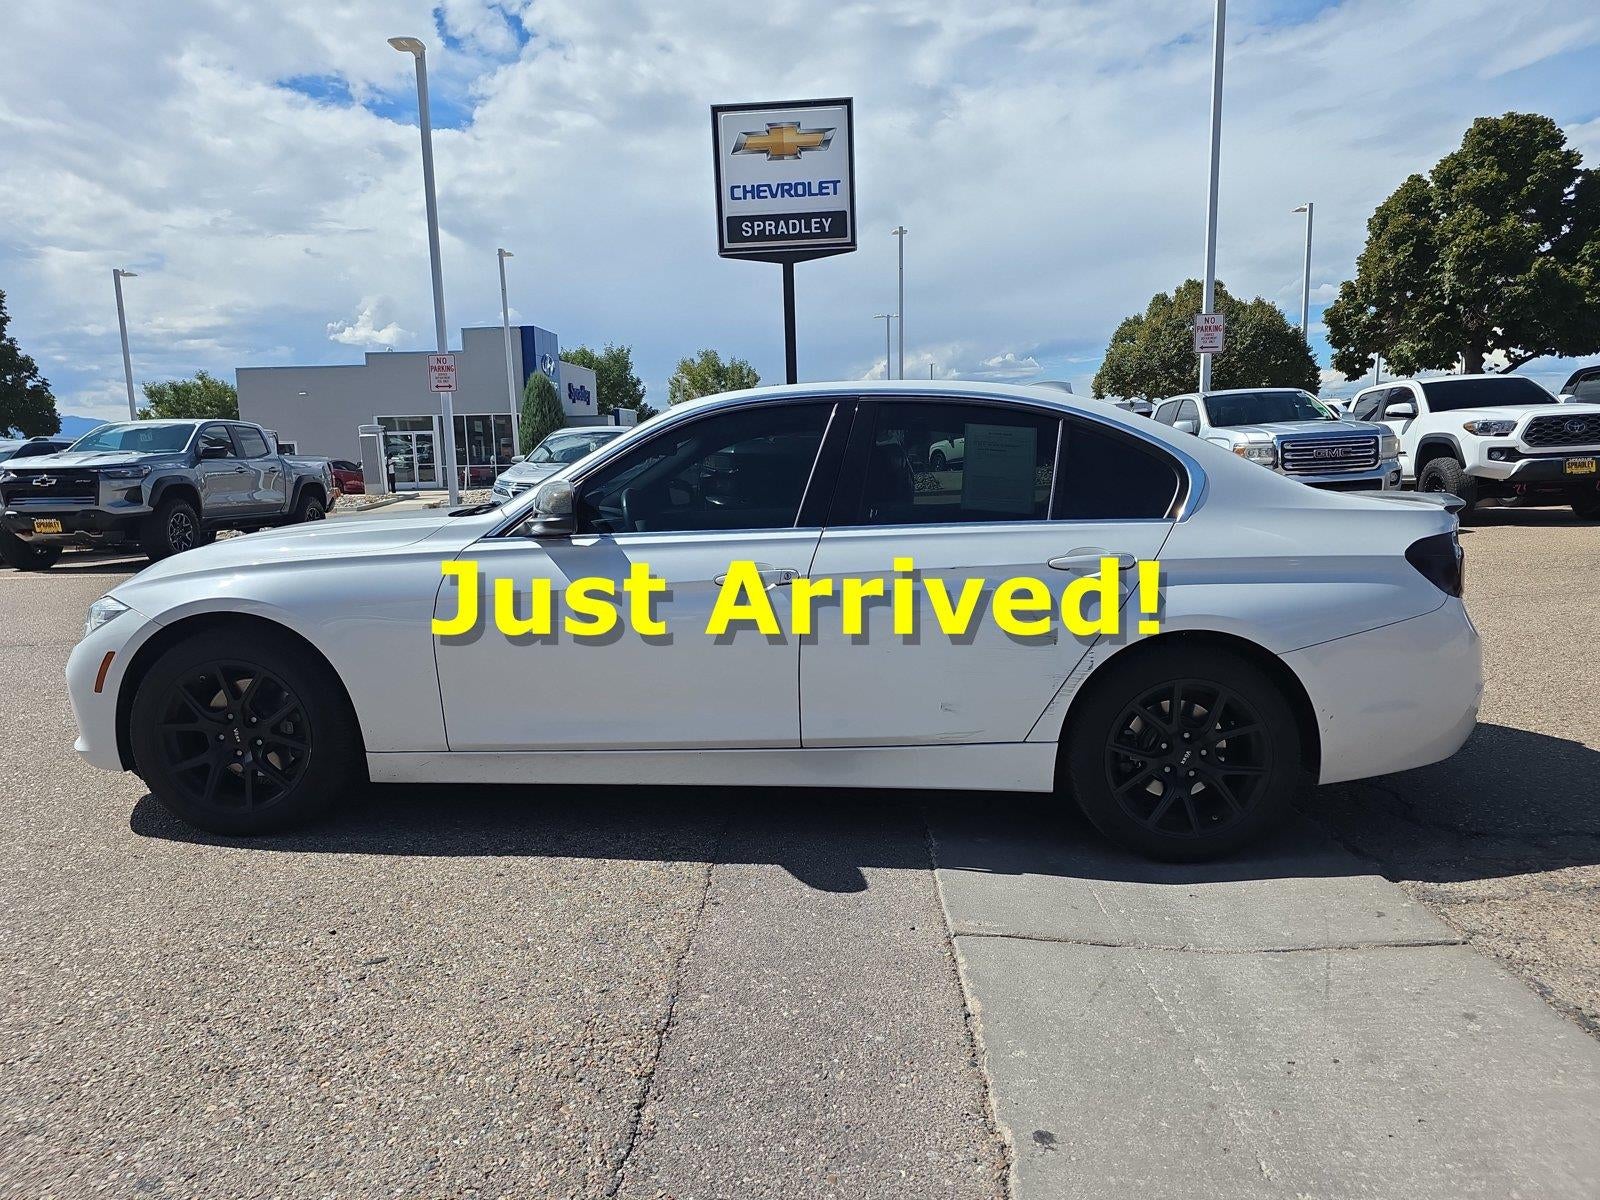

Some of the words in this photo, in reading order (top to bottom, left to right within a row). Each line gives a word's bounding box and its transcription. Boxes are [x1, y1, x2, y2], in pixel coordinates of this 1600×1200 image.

[730, 180, 841, 200] CHEVROLET
[741, 217, 832, 237] SPRADLEY
[1196, 325, 1223, 333] PARKING
[430, 365, 455, 373] PARKING
[1313, 448, 1352, 458] GMC
